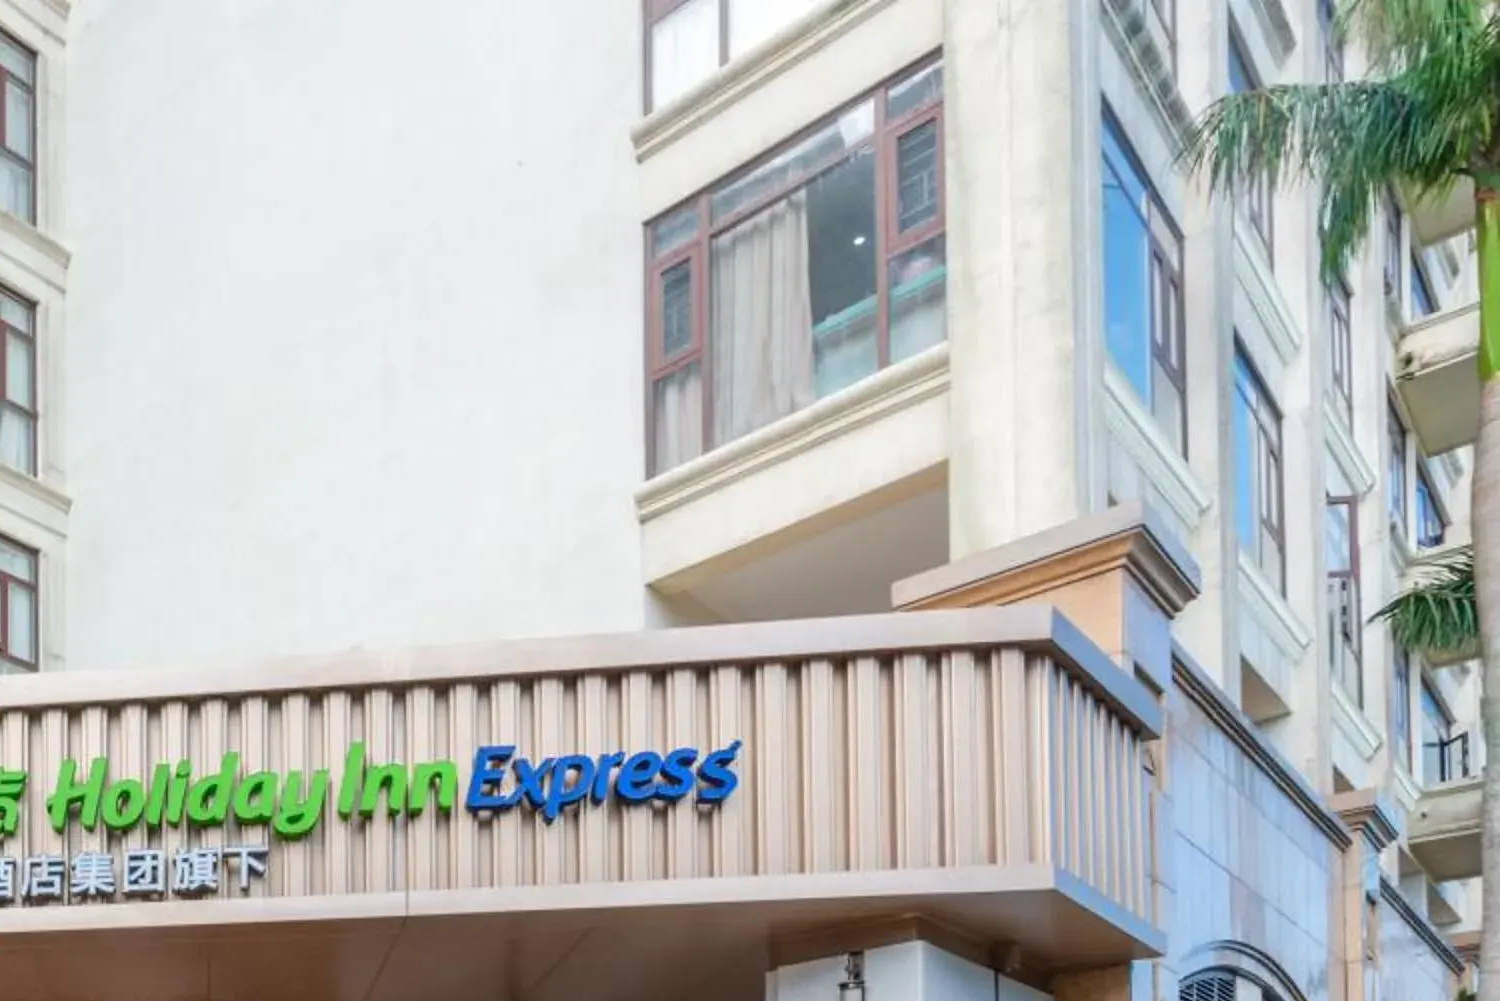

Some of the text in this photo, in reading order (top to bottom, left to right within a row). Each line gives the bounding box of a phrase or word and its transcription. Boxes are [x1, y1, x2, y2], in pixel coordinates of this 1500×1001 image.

[47, 740, 743, 840] Holiday Inn Express
